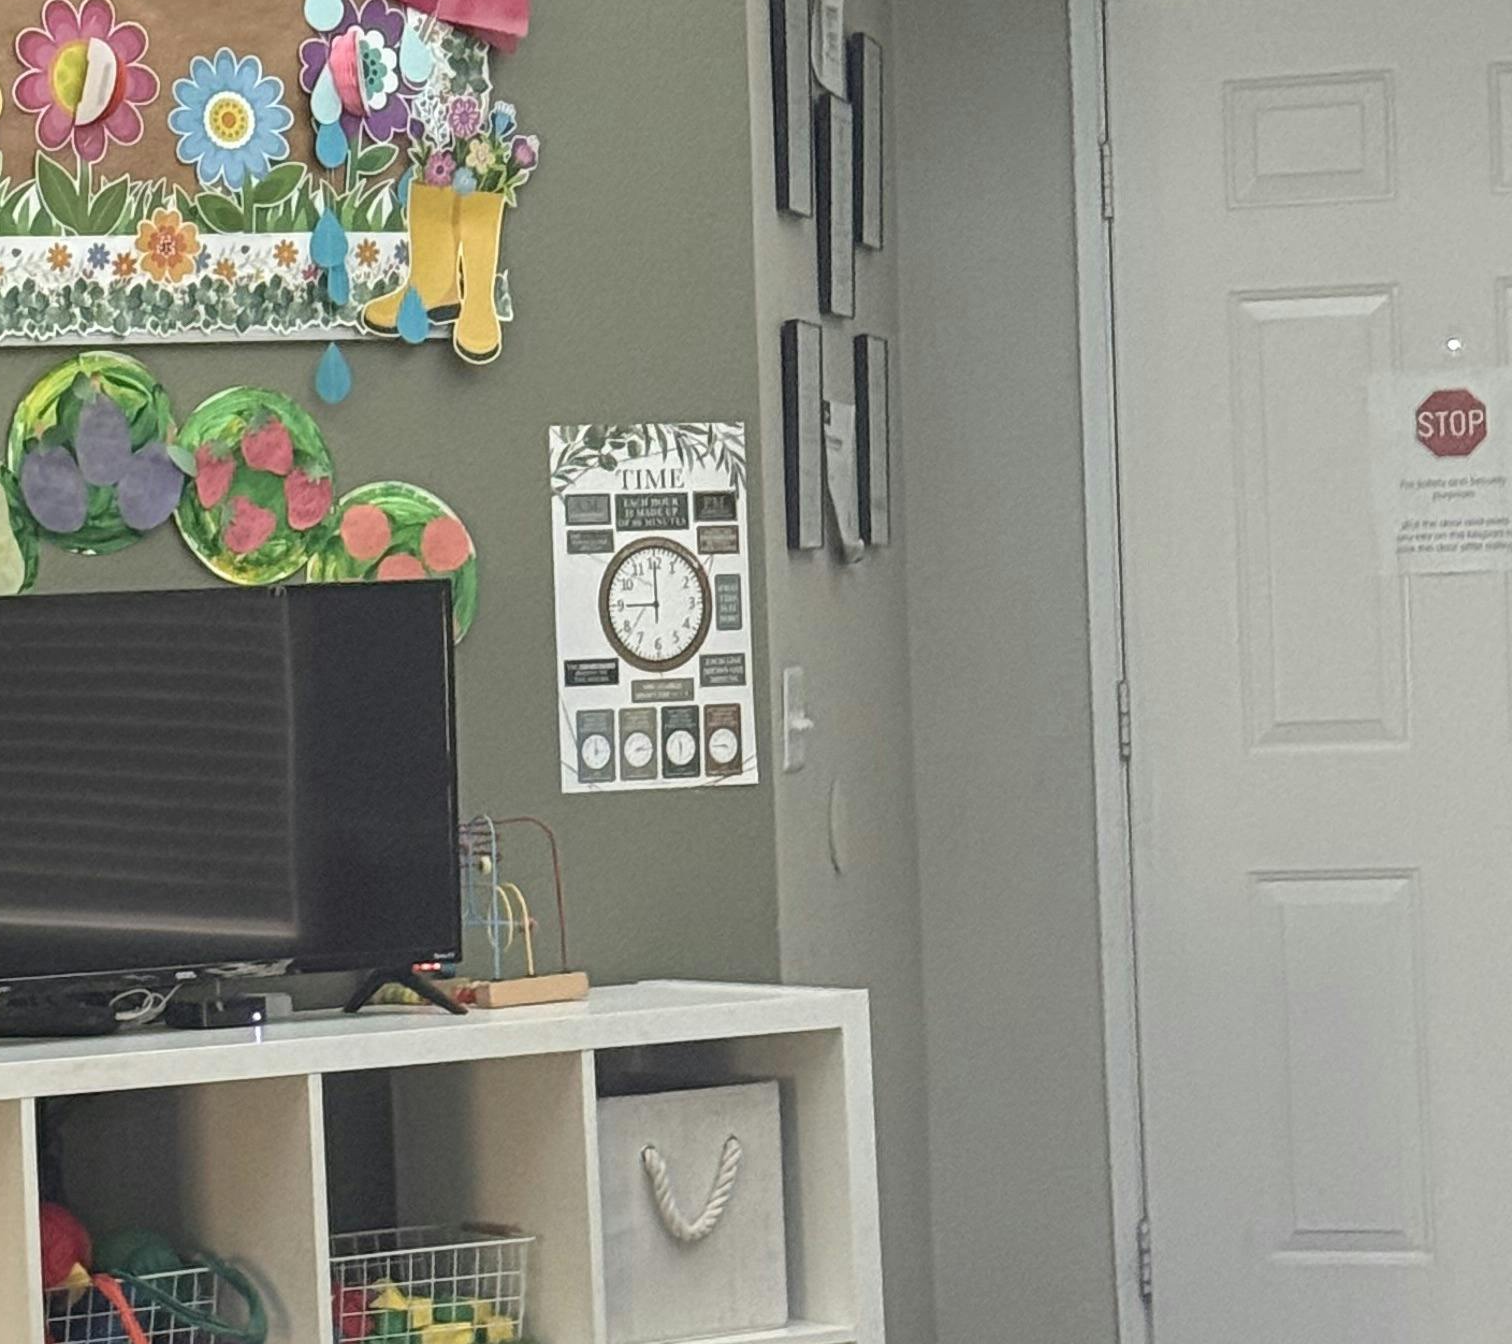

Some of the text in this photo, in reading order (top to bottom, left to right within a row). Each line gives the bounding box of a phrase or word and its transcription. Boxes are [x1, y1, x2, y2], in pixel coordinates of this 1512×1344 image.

[1417, 408, 1484, 439] STOP
[618, 469, 685, 490] TIME
[633, 563, 644, 577] 11
[648, 557, 662, 570] 12
[669, 561, 676, 574] 1
[621, 578, 634, 591] 10
[683, 576, 690, 589] 2
[616, 599, 624, 612] 9
[689, 597, 696, 610] 3
[623, 620, 632, 633] 8
[682, 617, 691, 629] 4
[637, 631, 644, 644] 7
[654, 637, 662, 650] 6
[673, 630, 680, 644] 5
